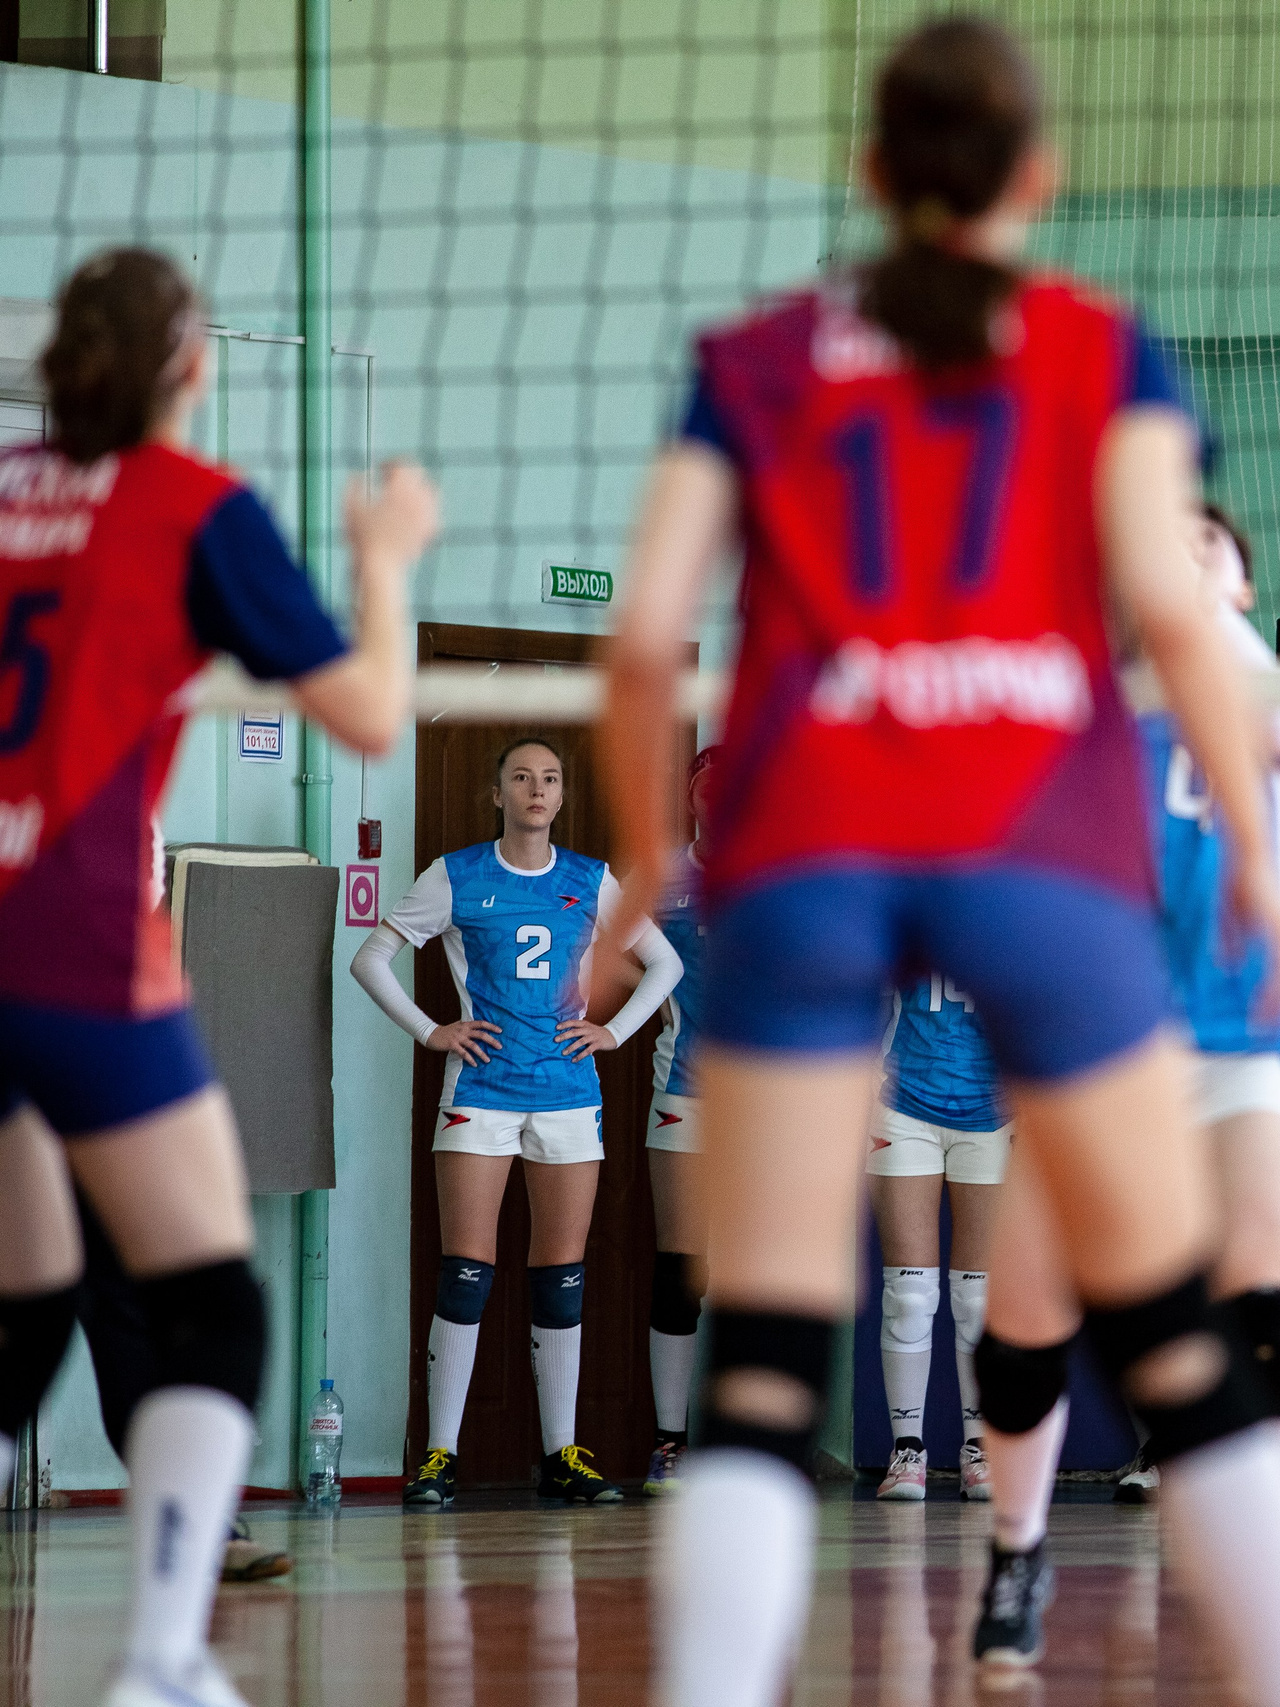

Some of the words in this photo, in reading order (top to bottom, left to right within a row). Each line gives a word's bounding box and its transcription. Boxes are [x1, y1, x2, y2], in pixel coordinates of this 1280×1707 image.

[832, 385, 1018, 608] 17
[556, 570, 609, 600] ВЫХОД
[245, 735, 277, 750] 101,112
[515, 924, 552, 980] 2
